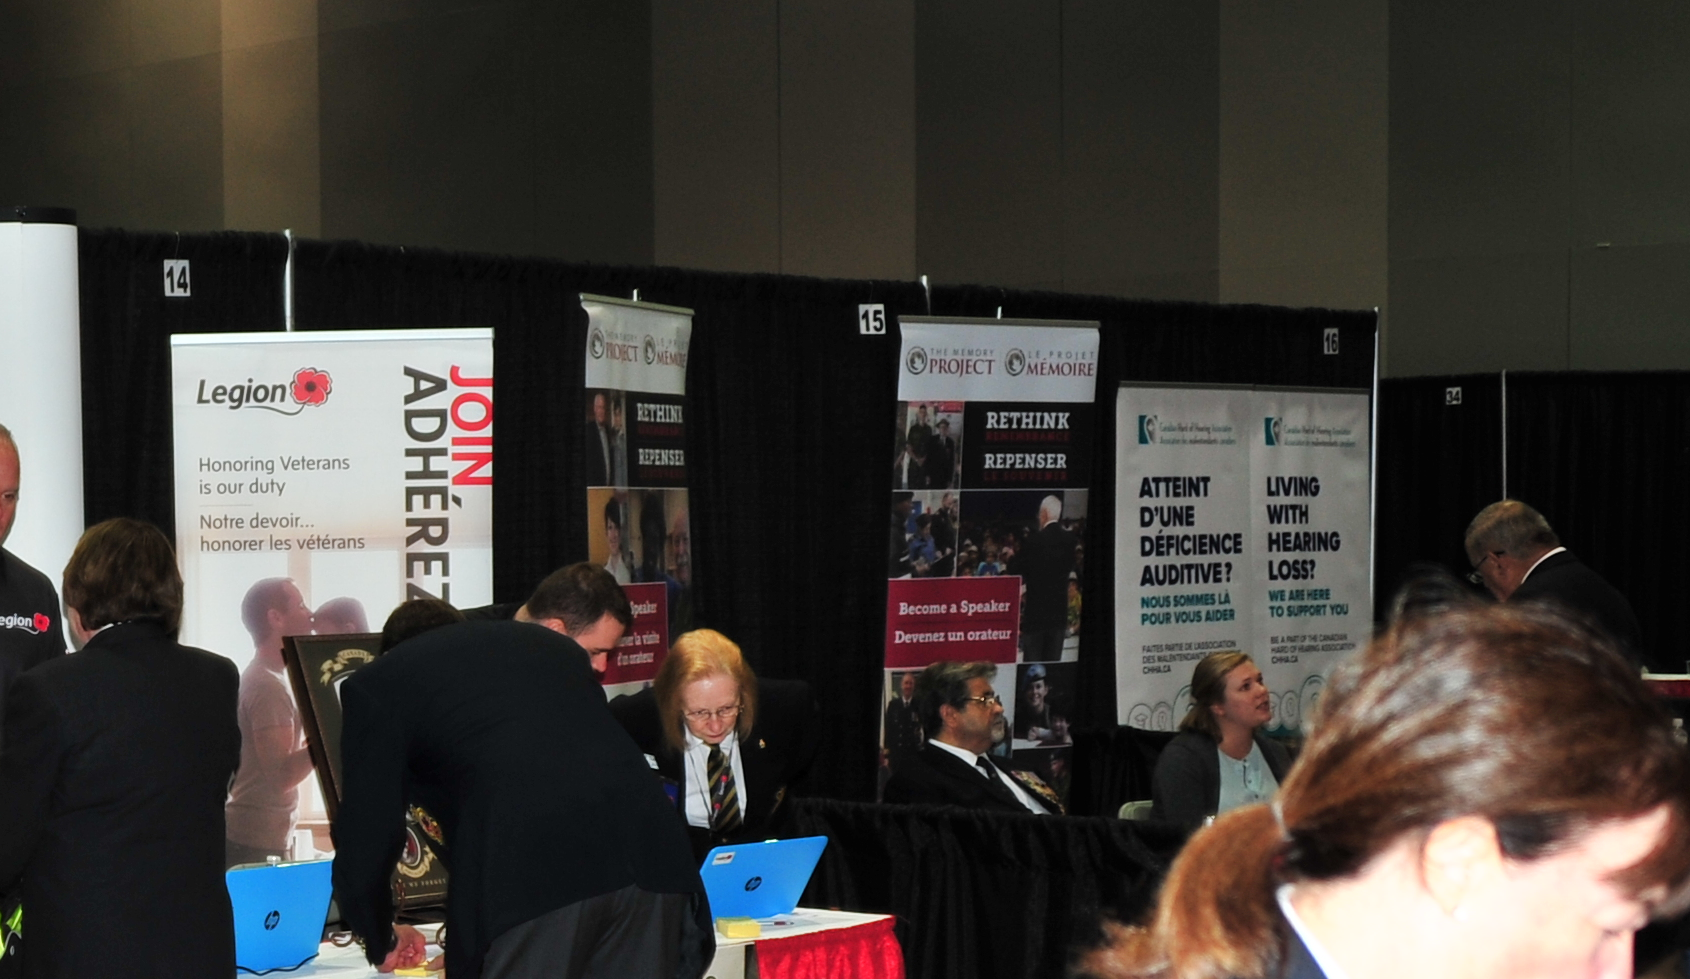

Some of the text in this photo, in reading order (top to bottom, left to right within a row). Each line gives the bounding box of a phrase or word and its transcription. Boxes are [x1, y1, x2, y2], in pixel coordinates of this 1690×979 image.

[165, 266, 189, 294] 14
[861, 308, 884, 333] 15
[1325, 332, 1338, 353] 16
[930, 348, 995, 358] THE MEMORY
[1028, 351, 1095, 362] LE PROJET
[929, 358, 996, 377] PROJECT
[1026, 358, 1095, 377] MÉMOIRE
[197, 378, 287, 410] Legion
[637, 402, 684, 424] RETHINK
[986, 412, 1070, 429] RETHINK
[450, 364, 494, 486] JOIN
[199, 455, 351, 475] Honoring Veterans
[638, 448, 685, 466] REPENSER
[984, 453, 1068, 469] REPENSER
[199, 477, 286, 496] is our duty
[403, 365, 462, 602] ADHÉREZ
[1139, 476, 1211, 499] ATTEINT
[1266, 476, 1320, 497] LIVING
[200, 513, 245, 530] Notre
[1140, 505, 1195, 528] D'UNE
[1266, 504, 1309, 524] WITH
[200, 534, 366, 551] honorer les vétérans
[1140, 528, 1243, 557] DÉFICIENCE
[1268, 531, 1341, 552] HEARING
[1268, 559, 1316, 581] LOSS?
[1141, 595, 1172, 609] NOUS
[1173, 593, 1216, 608] SOMMES
[1268, 588, 1331, 602] WE ARE HERE
[899, 599, 1011, 616] Become a Speaker
[1141, 608, 1235, 626] POUR VOUS AIDER
[1269, 603, 1349, 618] TO SUPPORT YOU
[894, 628, 1012, 644] Devenez un orateur
[1142, 655, 1156, 664] DES
